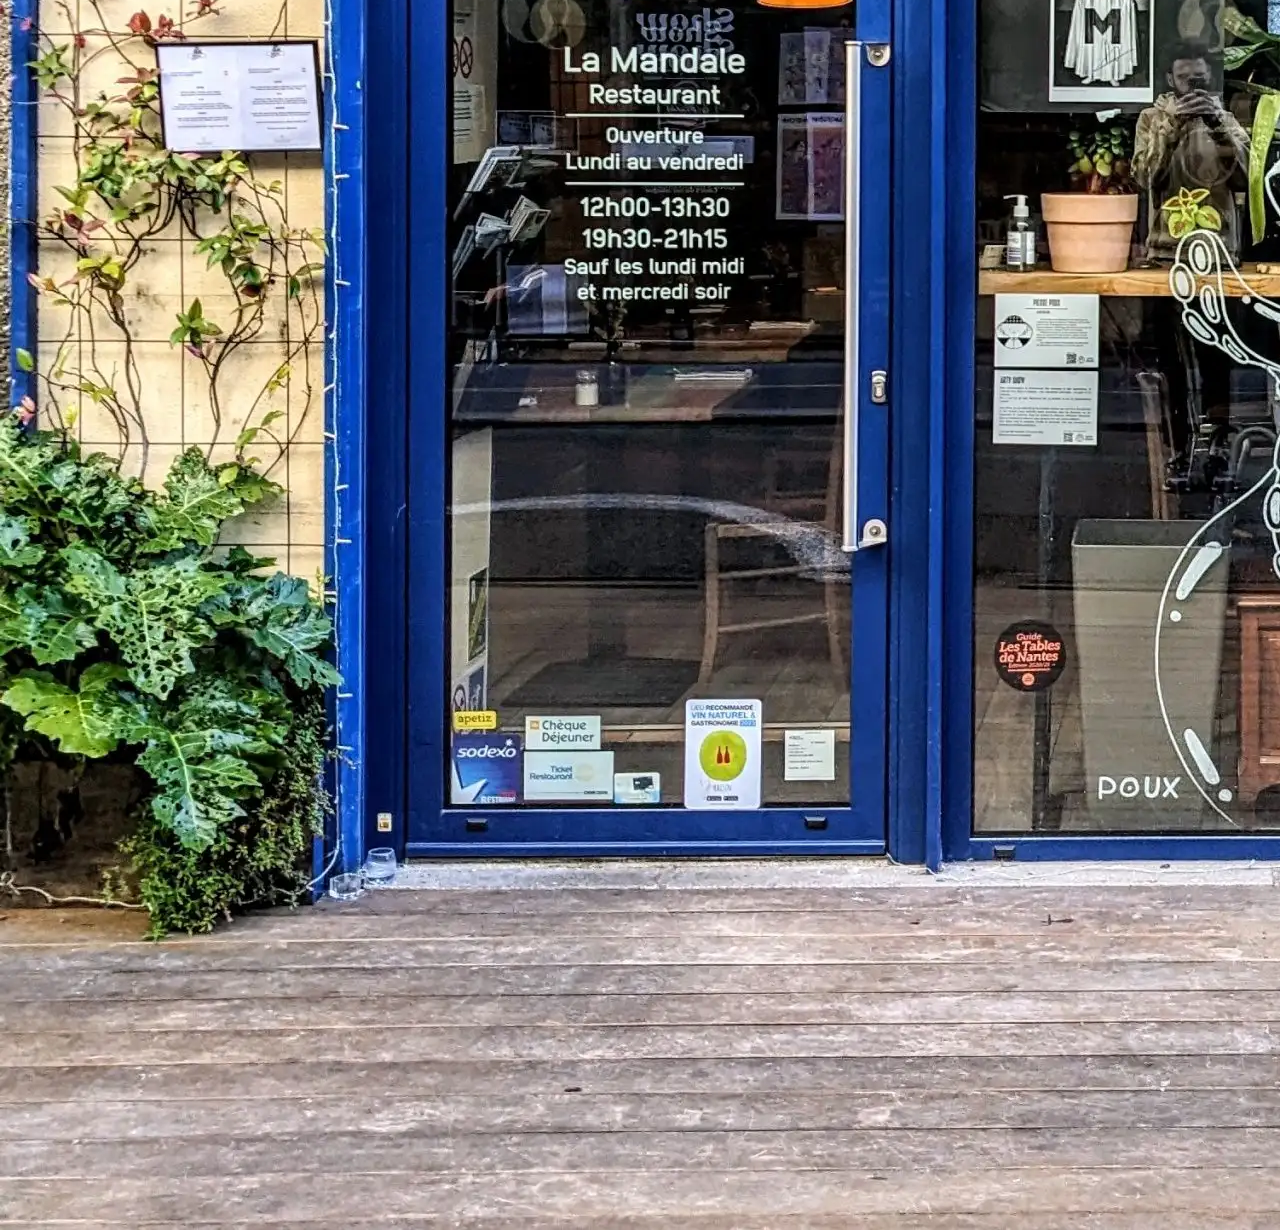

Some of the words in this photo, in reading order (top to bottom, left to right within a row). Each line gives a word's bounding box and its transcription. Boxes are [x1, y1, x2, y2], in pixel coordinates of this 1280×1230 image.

[1084, 8, 1122, 45] M
[564, 46, 600, 73] La
[611, 46, 746, 74] Mandale
[589, 83, 721, 105] Restaurant
[606, 126, 704, 144] Ouverture
[566, 152, 620, 170] Lundi
[626, 155, 652, 170] au
[658, 153, 744, 170] vendredi
[580, 196, 730, 217] 12h00-13h30
[582, 228, 728, 249] 19h30-21h15
[564, 257, 609, 275] Sauf
[615, 257, 643, 275] les
[649, 257, 696, 275] lundi
[702, 257, 745, 275] midi
[577, 283, 597, 300] et
[602, 283, 689, 300] mercredi
[694, 283, 731, 300] soir
[999, 641, 1020, 652] Les
[1021, 639, 1060, 651] Tables
[1016, 633, 1042, 641] Guide
[999, 652, 1015, 663] de
[1016, 651, 1059, 662] Nantes
[457, 713, 493, 725] apetiz
[542, 720, 587, 731] Chèque
[541, 731, 595, 744] Déjeuner
[457, 744, 517, 759] sodexo
[529, 773, 573, 781] Restaurant
[551, 765, 573, 773] Ticket
[1098, 776, 1181, 800] POUX
